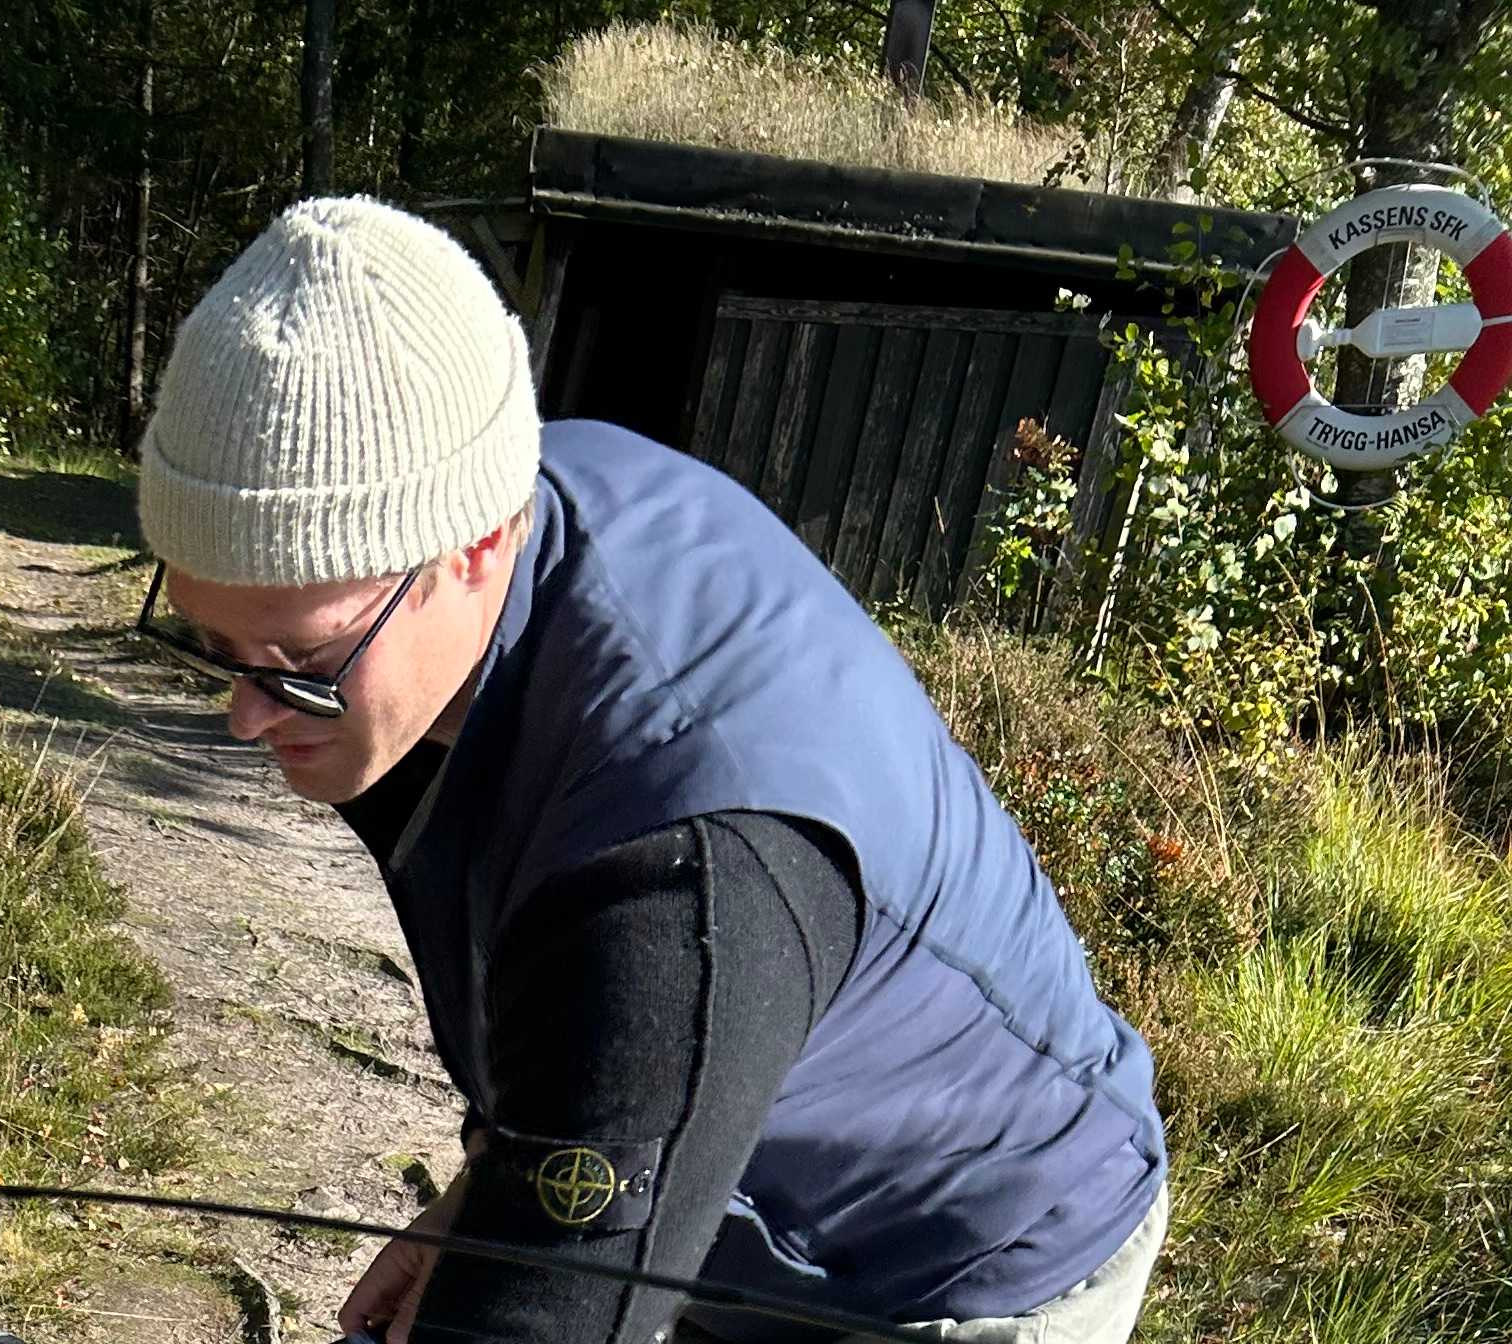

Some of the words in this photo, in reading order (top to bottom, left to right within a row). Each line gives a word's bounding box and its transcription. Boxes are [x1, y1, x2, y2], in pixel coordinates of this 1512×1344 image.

[1328, 206, 1428, 249] KASSENS
[1430, 210, 1468, 241] SFK
[1308, 410, 1445, 450] TRYGG-HANSA
